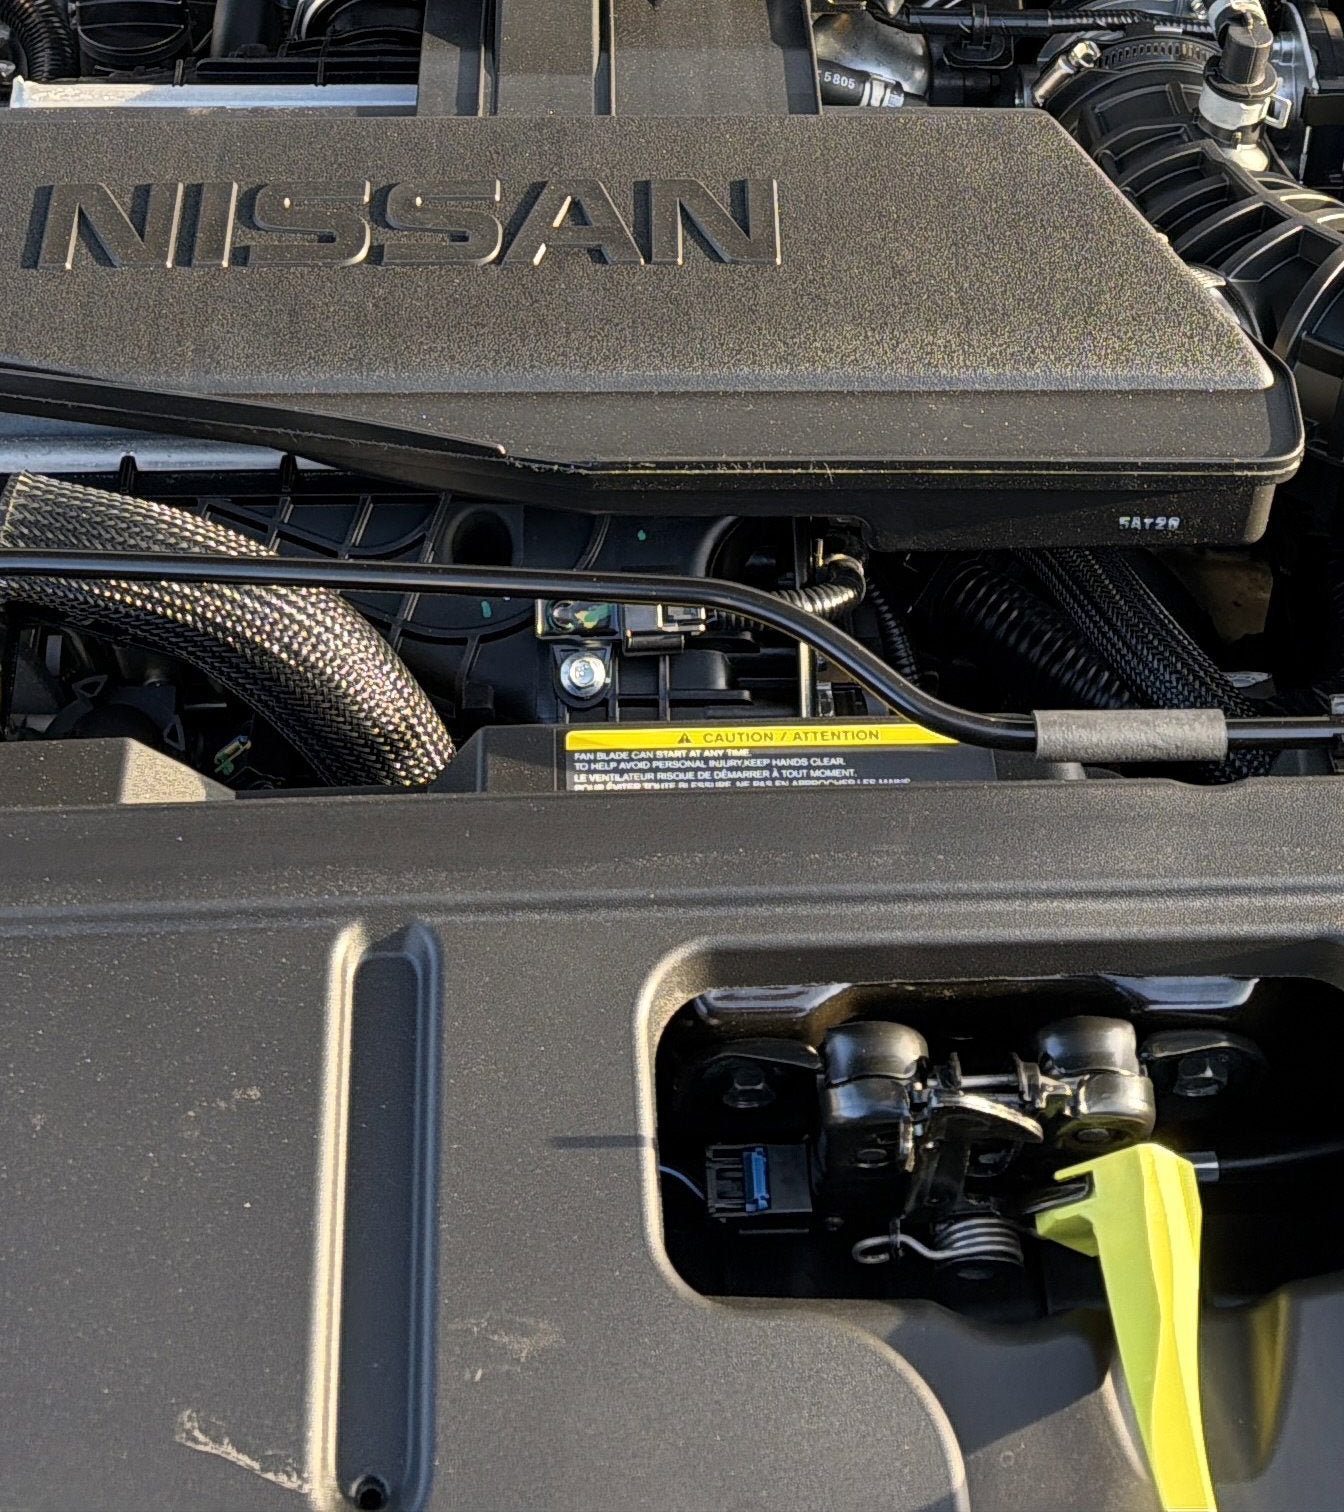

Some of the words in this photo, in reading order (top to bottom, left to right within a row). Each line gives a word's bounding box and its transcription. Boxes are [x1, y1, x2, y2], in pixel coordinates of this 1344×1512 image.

[24, 178, 782, 270] NISSAN
[702, 731, 774, 744] CAUTION
[793, 729, 880, 742] ATTENTION
[574, 751, 594, 761] FAN
[596, 751, 629, 760] BLADE
[630, 750, 656, 760] CAN
[656, 749, 689, 759] START
[689, 749, 702, 758] AT
[703, 749, 725, 758] ANY
[726, 748, 753, 757] TIME.
[574, 762, 589, 771] TO
[590, 761, 618, 771] HELP
[618, 760, 651, 770] AVOID
[652, 759, 707, 769] PERSONAL
[772, 757, 808, 767] HANDS
[810, 757, 846, 766] CLEAR.
[574, 773, 588, 783] LE
[589, 771, 655, 783] VENTILATEUR
[656, 771, 696, 781] RISQUE
[697, 770, 712, 780] DE
[713, 768, 771, 779] DÉMARRER
[772, 767, 780, 777] À
[781, 768, 807, 778] TOUT
[810, 768, 858, 777] MOMENT.
